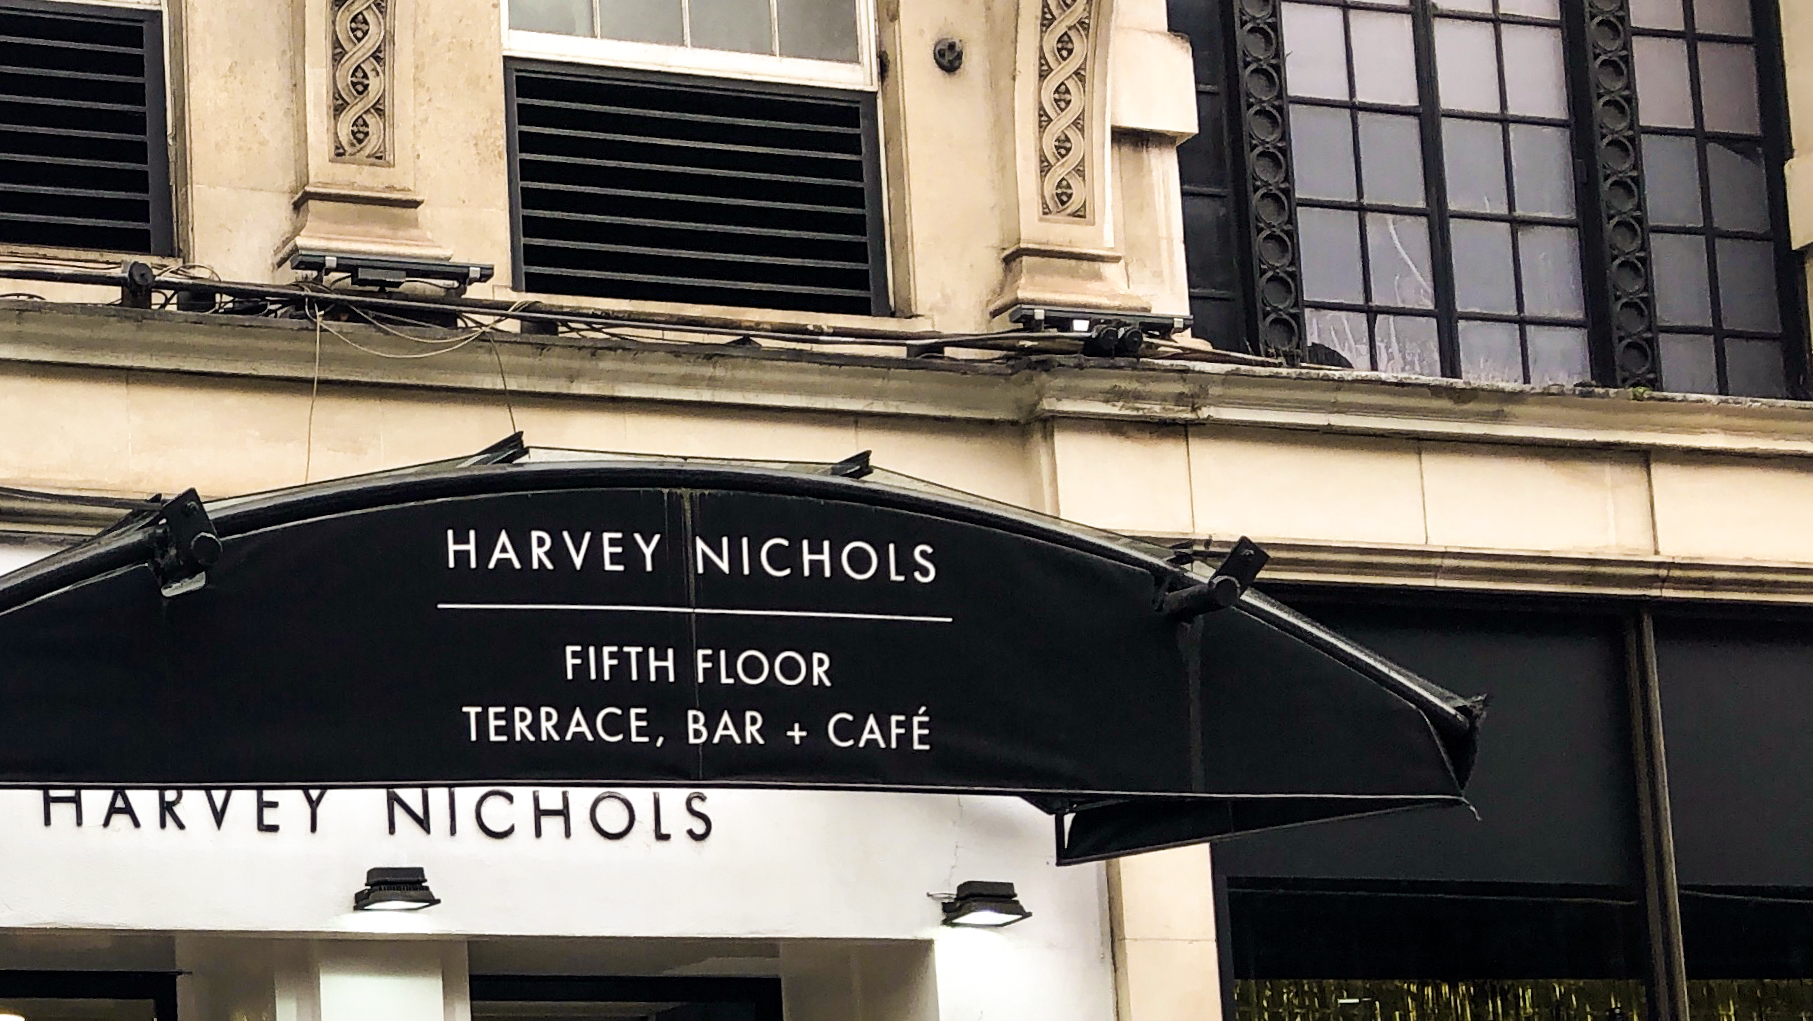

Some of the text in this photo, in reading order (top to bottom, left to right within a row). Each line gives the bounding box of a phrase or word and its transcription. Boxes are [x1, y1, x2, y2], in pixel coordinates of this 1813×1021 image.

[446, 528, 937, 583] HARVEY NICHOLS
[565, 645, 831, 687] FIFTH FLOOR
[462, 706, 930, 751] TERRACE, BAR + CAFÉ
[42, 789, 713, 842] HARVEY NICHOLS
